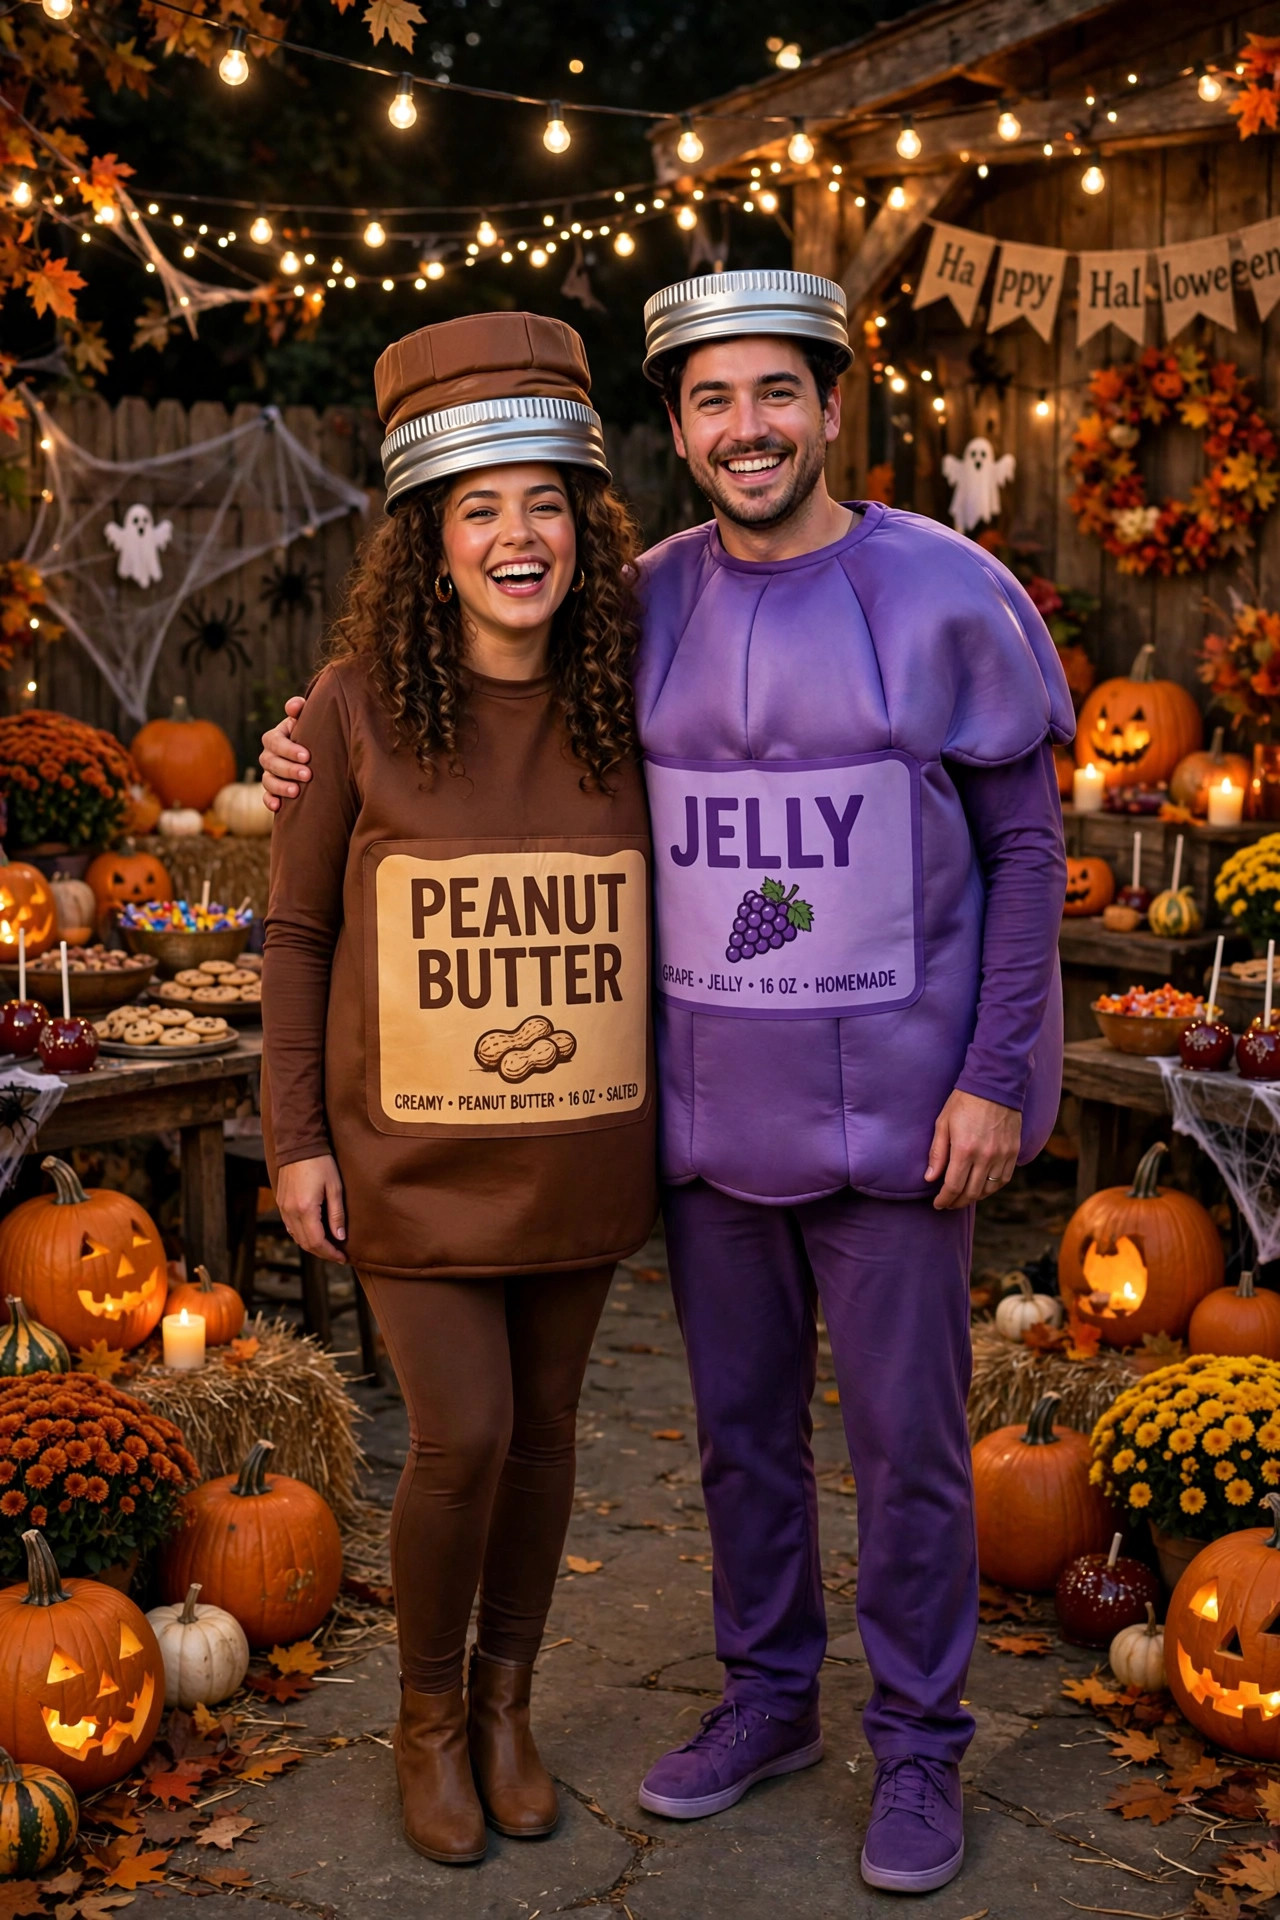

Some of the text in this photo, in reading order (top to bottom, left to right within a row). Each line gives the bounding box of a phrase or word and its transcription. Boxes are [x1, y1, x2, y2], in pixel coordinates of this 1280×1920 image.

[936, 242, 1054, 310] Happy
[670, 794, 865, 869] JELLY
[411, 873, 627, 939] PEANUT
[418, 943, 623, 1009] BUTTER
[662, 964, 897, 994] GRAPE JELLY 16 OZ HOMEMADE
[394, 1083, 639, 1111] CREAMY PEANUT BUTTER 16 OZ SALTED
